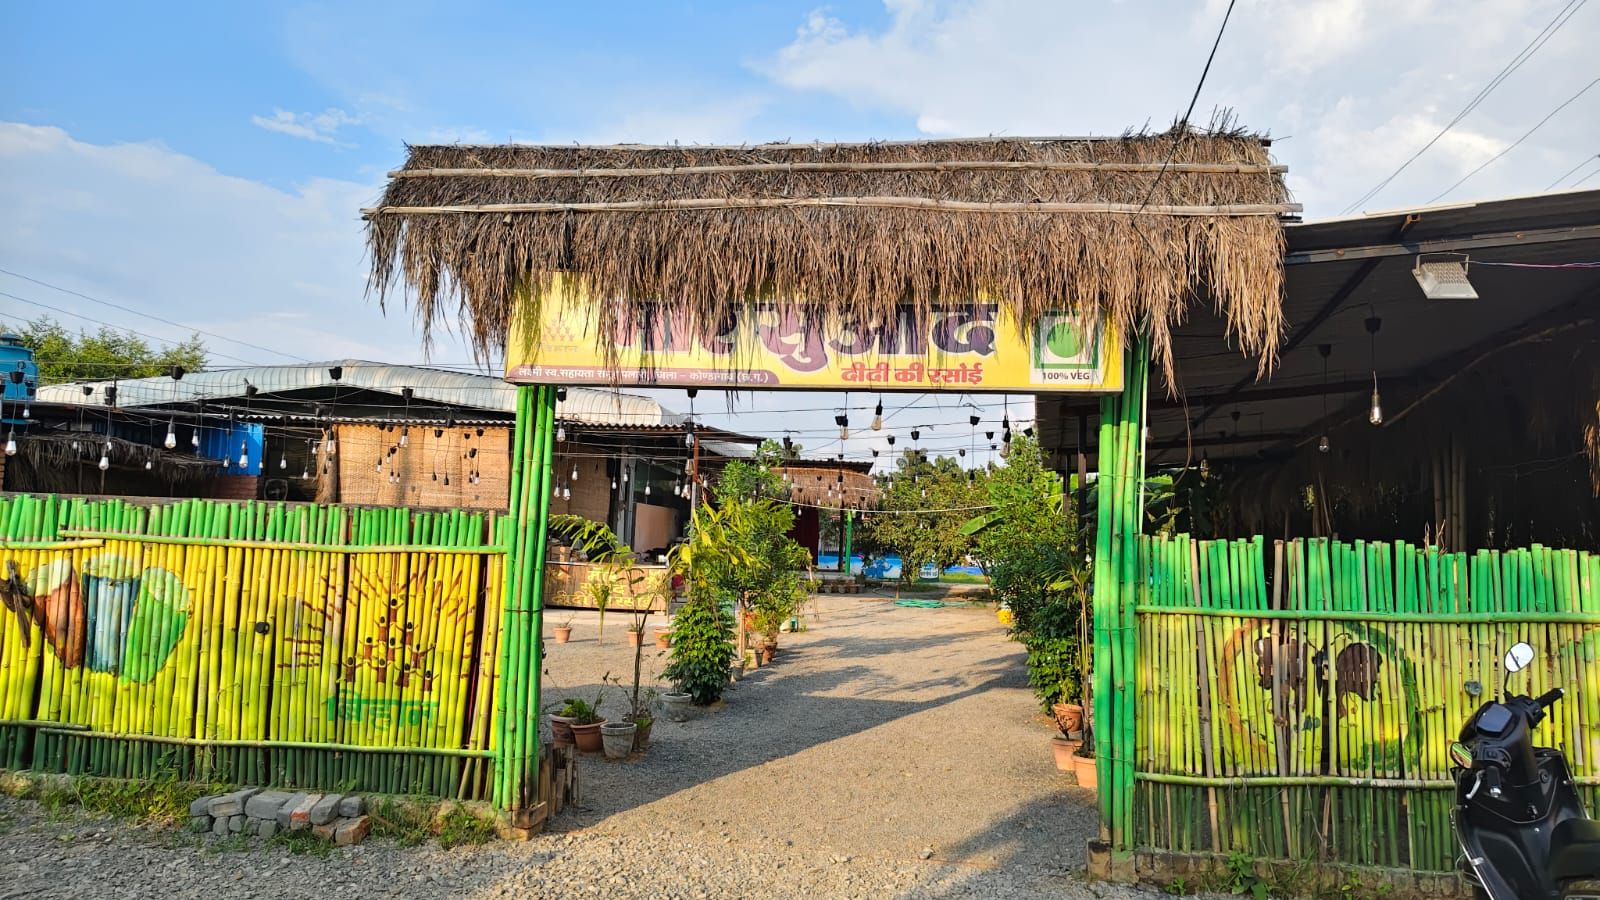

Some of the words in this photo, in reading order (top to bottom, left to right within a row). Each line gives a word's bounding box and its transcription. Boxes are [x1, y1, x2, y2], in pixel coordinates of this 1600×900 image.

[841, 362, 890, 382] दीदी
[894, 362, 924, 382] की
[928, 362, 983, 385] रसोई
[1042, 372, 1069, 380] 100%
[1070, 372, 1090, 380] VEG
